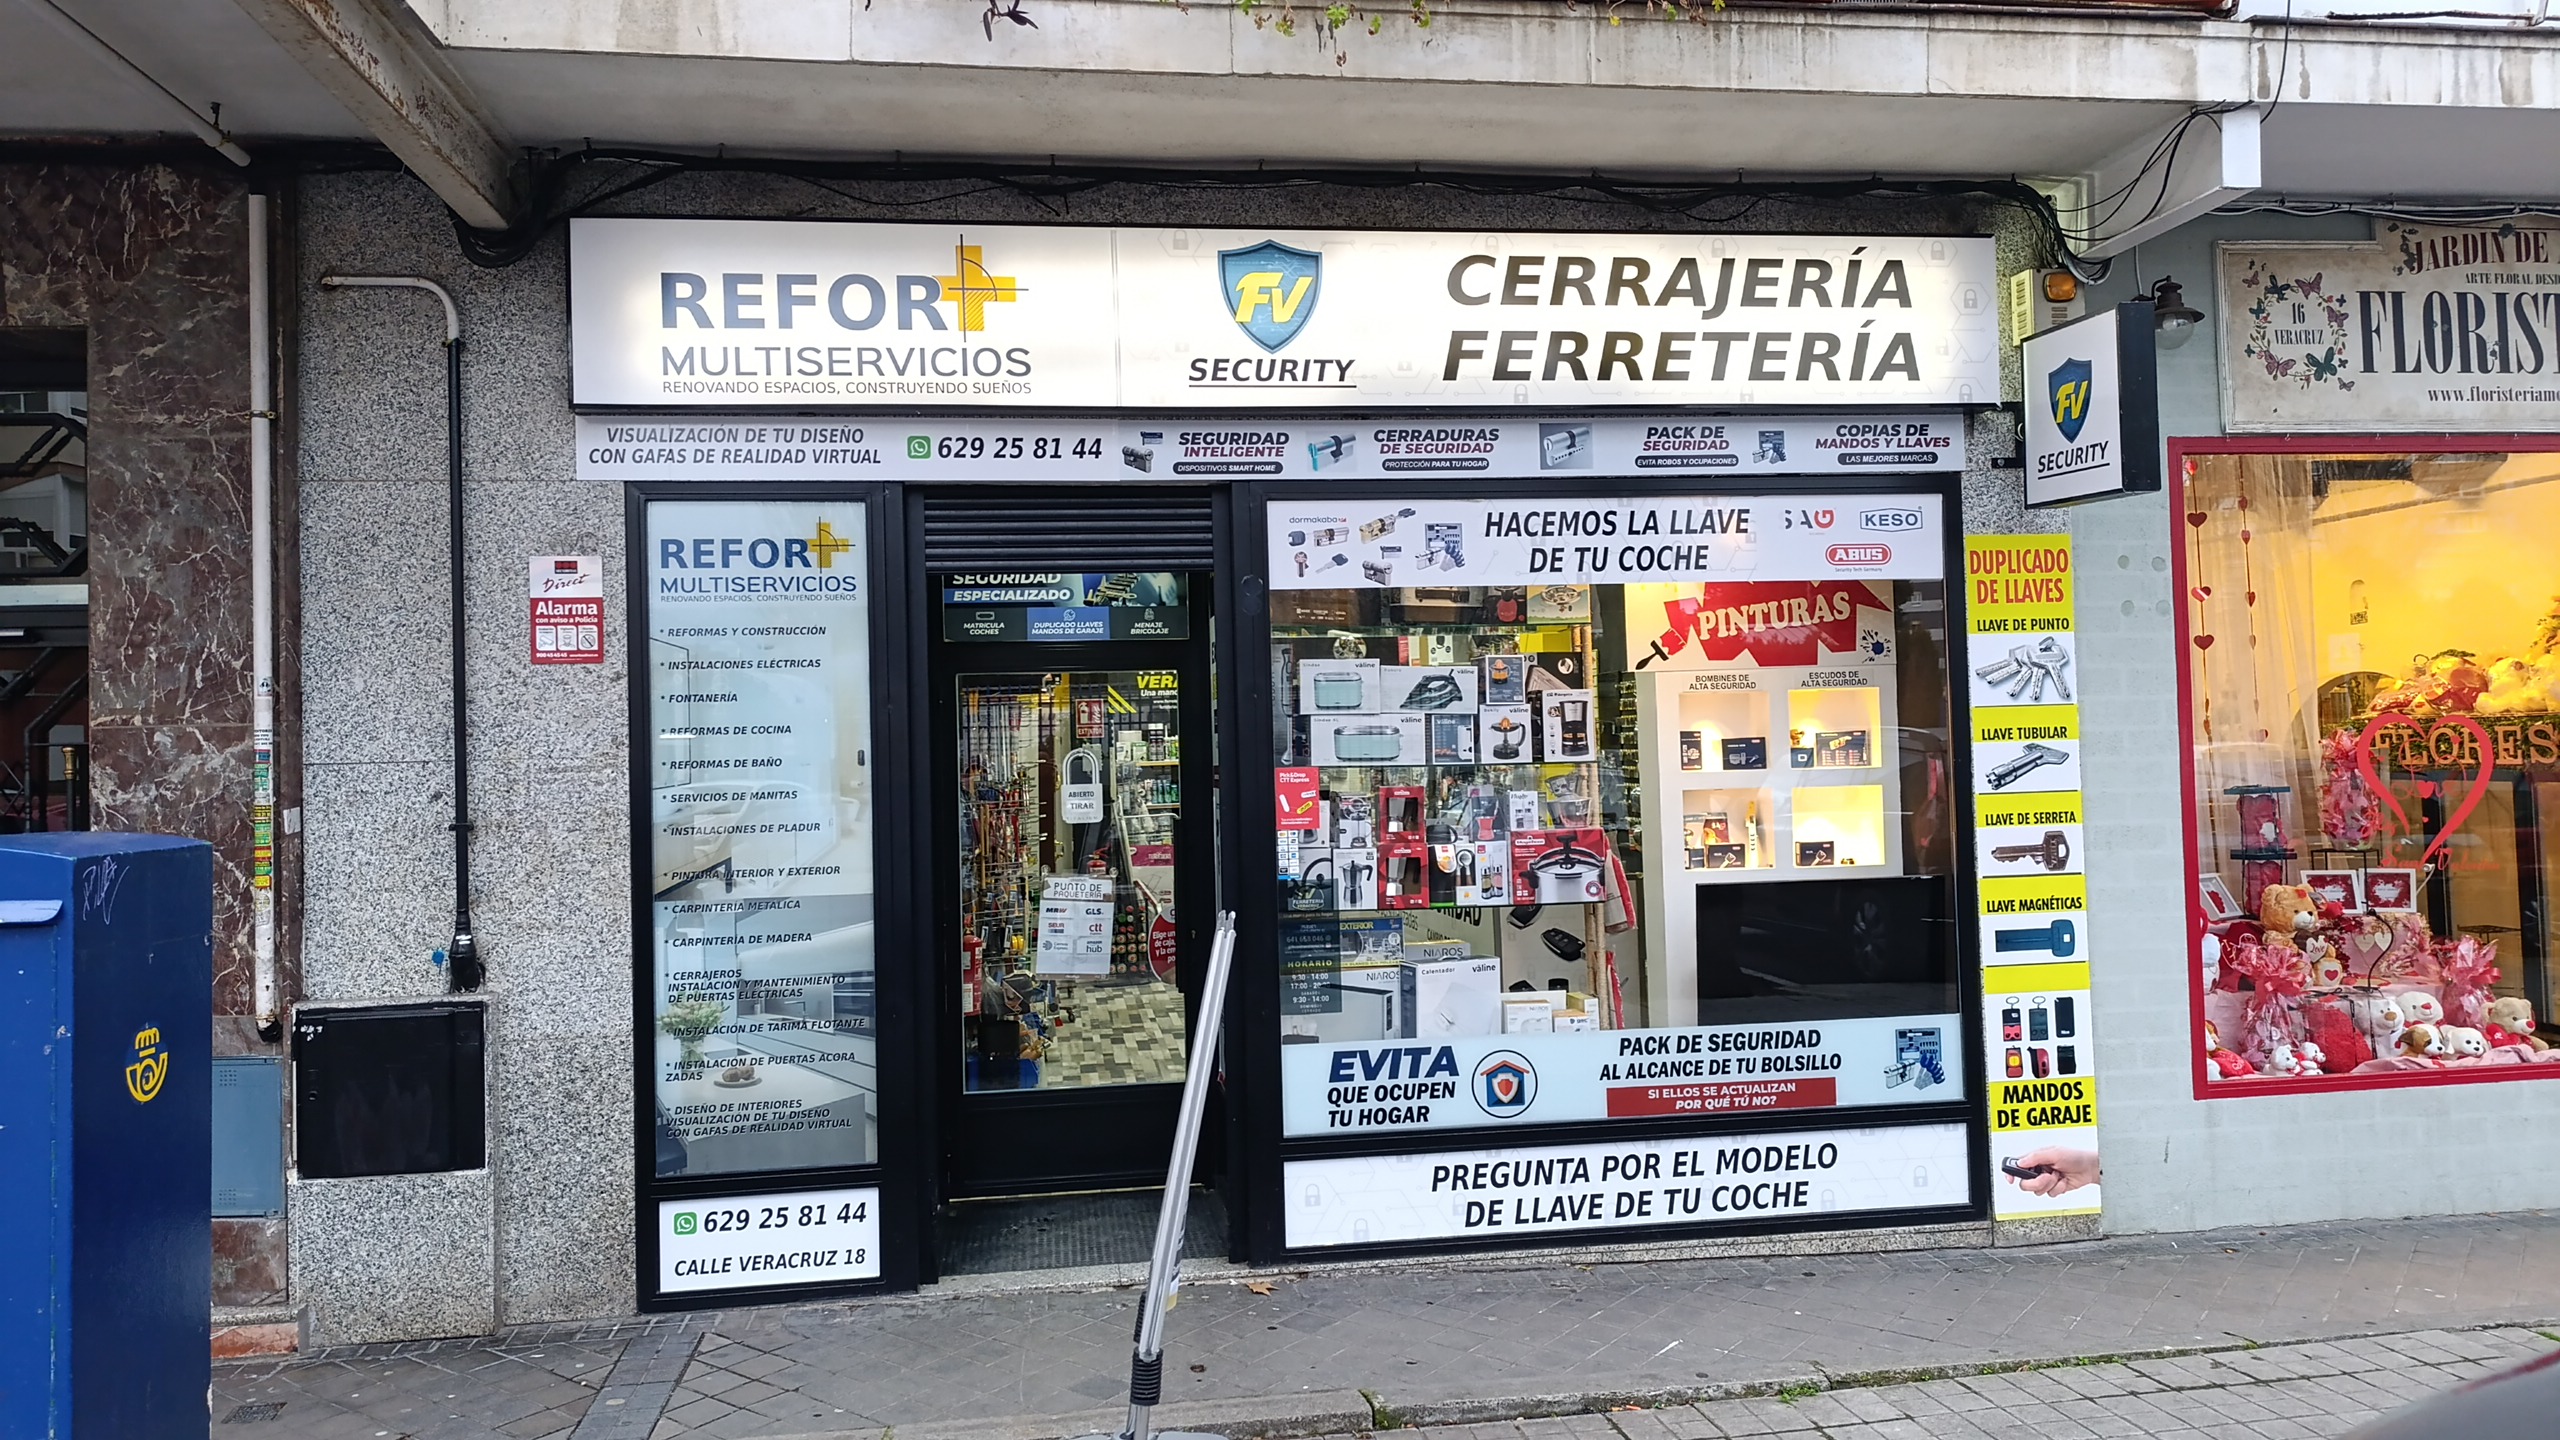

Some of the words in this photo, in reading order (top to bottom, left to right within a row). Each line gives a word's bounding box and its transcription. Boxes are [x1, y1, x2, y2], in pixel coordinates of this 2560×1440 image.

[2409, 232, 2506, 276] JARDIN
[2515, 231, 2549, 264] DE
[1446, 246, 1914, 321] CERRAJERÍA
[2465, 273, 2491, 284] ARTE
[2494, 273, 2533, 284] FLORAL
[1234, 270, 1304, 324] FV
[2291, 302, 2306, 325] 16
[2274, 329, 2325, 346] VERACRUZ
[1441, 319, 1921, 383] FERRETERÍA
[661, 346, 1032, 377] MULTISERVICIOS
[1189, 357, 1356, 383] SECURITY
[663, 381, 759, 394] RENOVANDO
[764, 382, 840, 395] ESPACIOS,
[845, 382, 967, 395] CONSTRUYENDO
[972, 379, 1032, 395] SUEÑOS
[2055, 381, 2088, 423] FV
[607, 425, 740, 444] VISUALIZACIÓN
[745, 427, 767, 443] DE
[772, 427, 796, 443] TU
[800, 425, 864, 443] DISEÑO
[1178, 432, 1290, 446] SEGURIDAD
[1373, 428, 1500, 443] CERRADURAS
[1646, 426, 1696, 440] PACK
[1699, 426, 1725, 439] DE
[1836, 424, 1901, 437] COPIAS
[1905, 424, 1929, 436] DE
[938, 436, 985, 460] 629
[993, 437, 1025, 460] 25
[1032, 437, 1063, 460] 81
[1071, 437, 1103, 460] 44
[1379, 443, 1403, 455] DE
[1404, 442, 1495, 455] SEGURIDAD
[1643, 438, 1730, 452] SEGURIDAD
[1815, 437, 1881, 449] MANDOS
[1883, 437, 1894, 449] Y
[1896, 437, 1951, 448] LLAVES
[589, 448, 628, 465] CON
[632, 448, 687, 465] GAFAS
[692, 448, 716, 464] DE
[720, 448, 806, 465] REALIDAD
[810, 448, 881, 465] VIRTUAL
[1184, 446, 1285, 458] INTELIGENTE
[2037, 440, 2110, 474] SECURITY
[1484, 510, 1617, 538] HACEMOS
[1627, 509, 1662, 535] LA
[1669, 508, 1751, 535] LLAVE
[1865, 513, 1918, 527] KESO
[1528, 546, 1571, 574] DE
[1575, 546, 1610, 573] TU
[1617, 544, 1710, 572] COCHE
[1834, 548, 1883, 561] ABUS
[1969, 548, 2069, 574] DUPLICADO
[543, 573, 591, 593] Direct
[660, 575, 857, 593] MULTISERVICIOS
[953, 574, 1062, 585] SEGURIDAD
[954, 589, 1070, 601] ESPECIALIZADO
[1977, 579, 1999, 604] DE
[2005, 578, 2064, 604] LLAVES
[535, 600, 597, 615] Alarma
[1697, 591, 1852, 641] PINTURAS
[668, 628, 727, 637] REFORMAS
[732, 627, 738, 636] Y
[741, 625, 826, 636] CONSTRUCCIÓN
[1977, 620, 2008, 631] LLAVE
[2013, 619, 2028, 631] DE
[2030, 618, 2070, 631] PUNTO
[668, 660, 753, 670] INSTALACIONES
[757, 658, 821, 669] ELÉCTRICAS
[1695, 674, 1737, 682] BOMBINES
[1738, 674, 1750, 682] DE
[1801, 679, 1820, 687] ALTA
[1822, 678, 1868, 687] SEGURIDAD
[1809, 672, 1847, 680] ESCUDOS
[1710, 682, 1756, 690] SEGURIDAD
[669, 692, 738, 703] FONTANERÍA
[1054, 882, 1086, 891] PUNTO
[1987, 900, 2016, 913] LLAVE
[2019, 895, 2082, 911] MAGNÉTICAS
[1340, 922, 1374, 930] EXTERIOR
[1424, 947, 1463, 957] NIAROS
[1288, 960, 1333, 968] HORARIO
[1421, 967, 1455, 975] Calentador
[673, 969, 742, 981] CERRAJEROS
[1619, 1035, 1671, 1057] PACK
[1675, 1034, 1704, 1054] DE
[1708, 1029, 1822, 1053] SEGURIDAD
[1327, 1045, 1460, 1084] EVITA
[1600, 1061, 1622, 1081] AL
[1625, 1059, 1705, 1080] ALCANCE
[1708, 1058, 1732, 1076] DE
[1735, 1055, 1757, 1075] TU
[1761, 1053, 1842, 1074] BOLSILLO
[1327, 1085, 1369, 1106] QUE
[1373, 1080, 1456, 1103] OCUPEN
[1648, 1086, 1659, 1099] SI
[1662, 1085, 1699, 1099] ELLOS
[1702, 1084, 1718, 1097] SE
[1721, 1081, 1796, 1097] ACTUALIZAN
[2002, 1081, 2084, 1105] MANDOS
[675, 1103, 716, 1115] DISEÑO
[719, 1104, 734, 1112] DE
[737, 1100, 802, 1111] INTERIORES
[1675, 1099, 1702, 1111] POR
[1704, 1095, 1729, 1110] QUÉ
[1732, 1094, 1748, 1108] TÚ
[1750, 1094, 1776, 1107] NO?
[1328, 1109, 1352, 1127] TU
[1357, 1104, 1430, 1126] HOGAR
[1997, 1109, 2020, 1129] DE
[2026, 1104, 2092, 1126] GARAJE
[1431, 1156, 1590, 1192] PREGUNTA
[1602, 1152, 1660, 1182] POR
[1672, 1149, 1705, 1178] EL
[1714, 1142, 1839, 1175] MODELO
[1464, 1201, 1508, 1229] DE
[1515, 1196, 1604, 1225] LLAVE
[1614, 1192, 1654, 1221] DE
[1664, 1189, 1702, 1216] TU
[1711, 1180, 1809, 1211] COCHE
[704, 1209, 750, 1233] 629
[759, 1207, 789, 1229] 25
[798, 1205, 827, 1227] 81
[837, 1202, 867, 1224] 44
[674, 1258, 732, 1276] CALLE
[739, 1250, 838, 1272] VERACRUZ
[844, 1249, 866, 1265] 18
